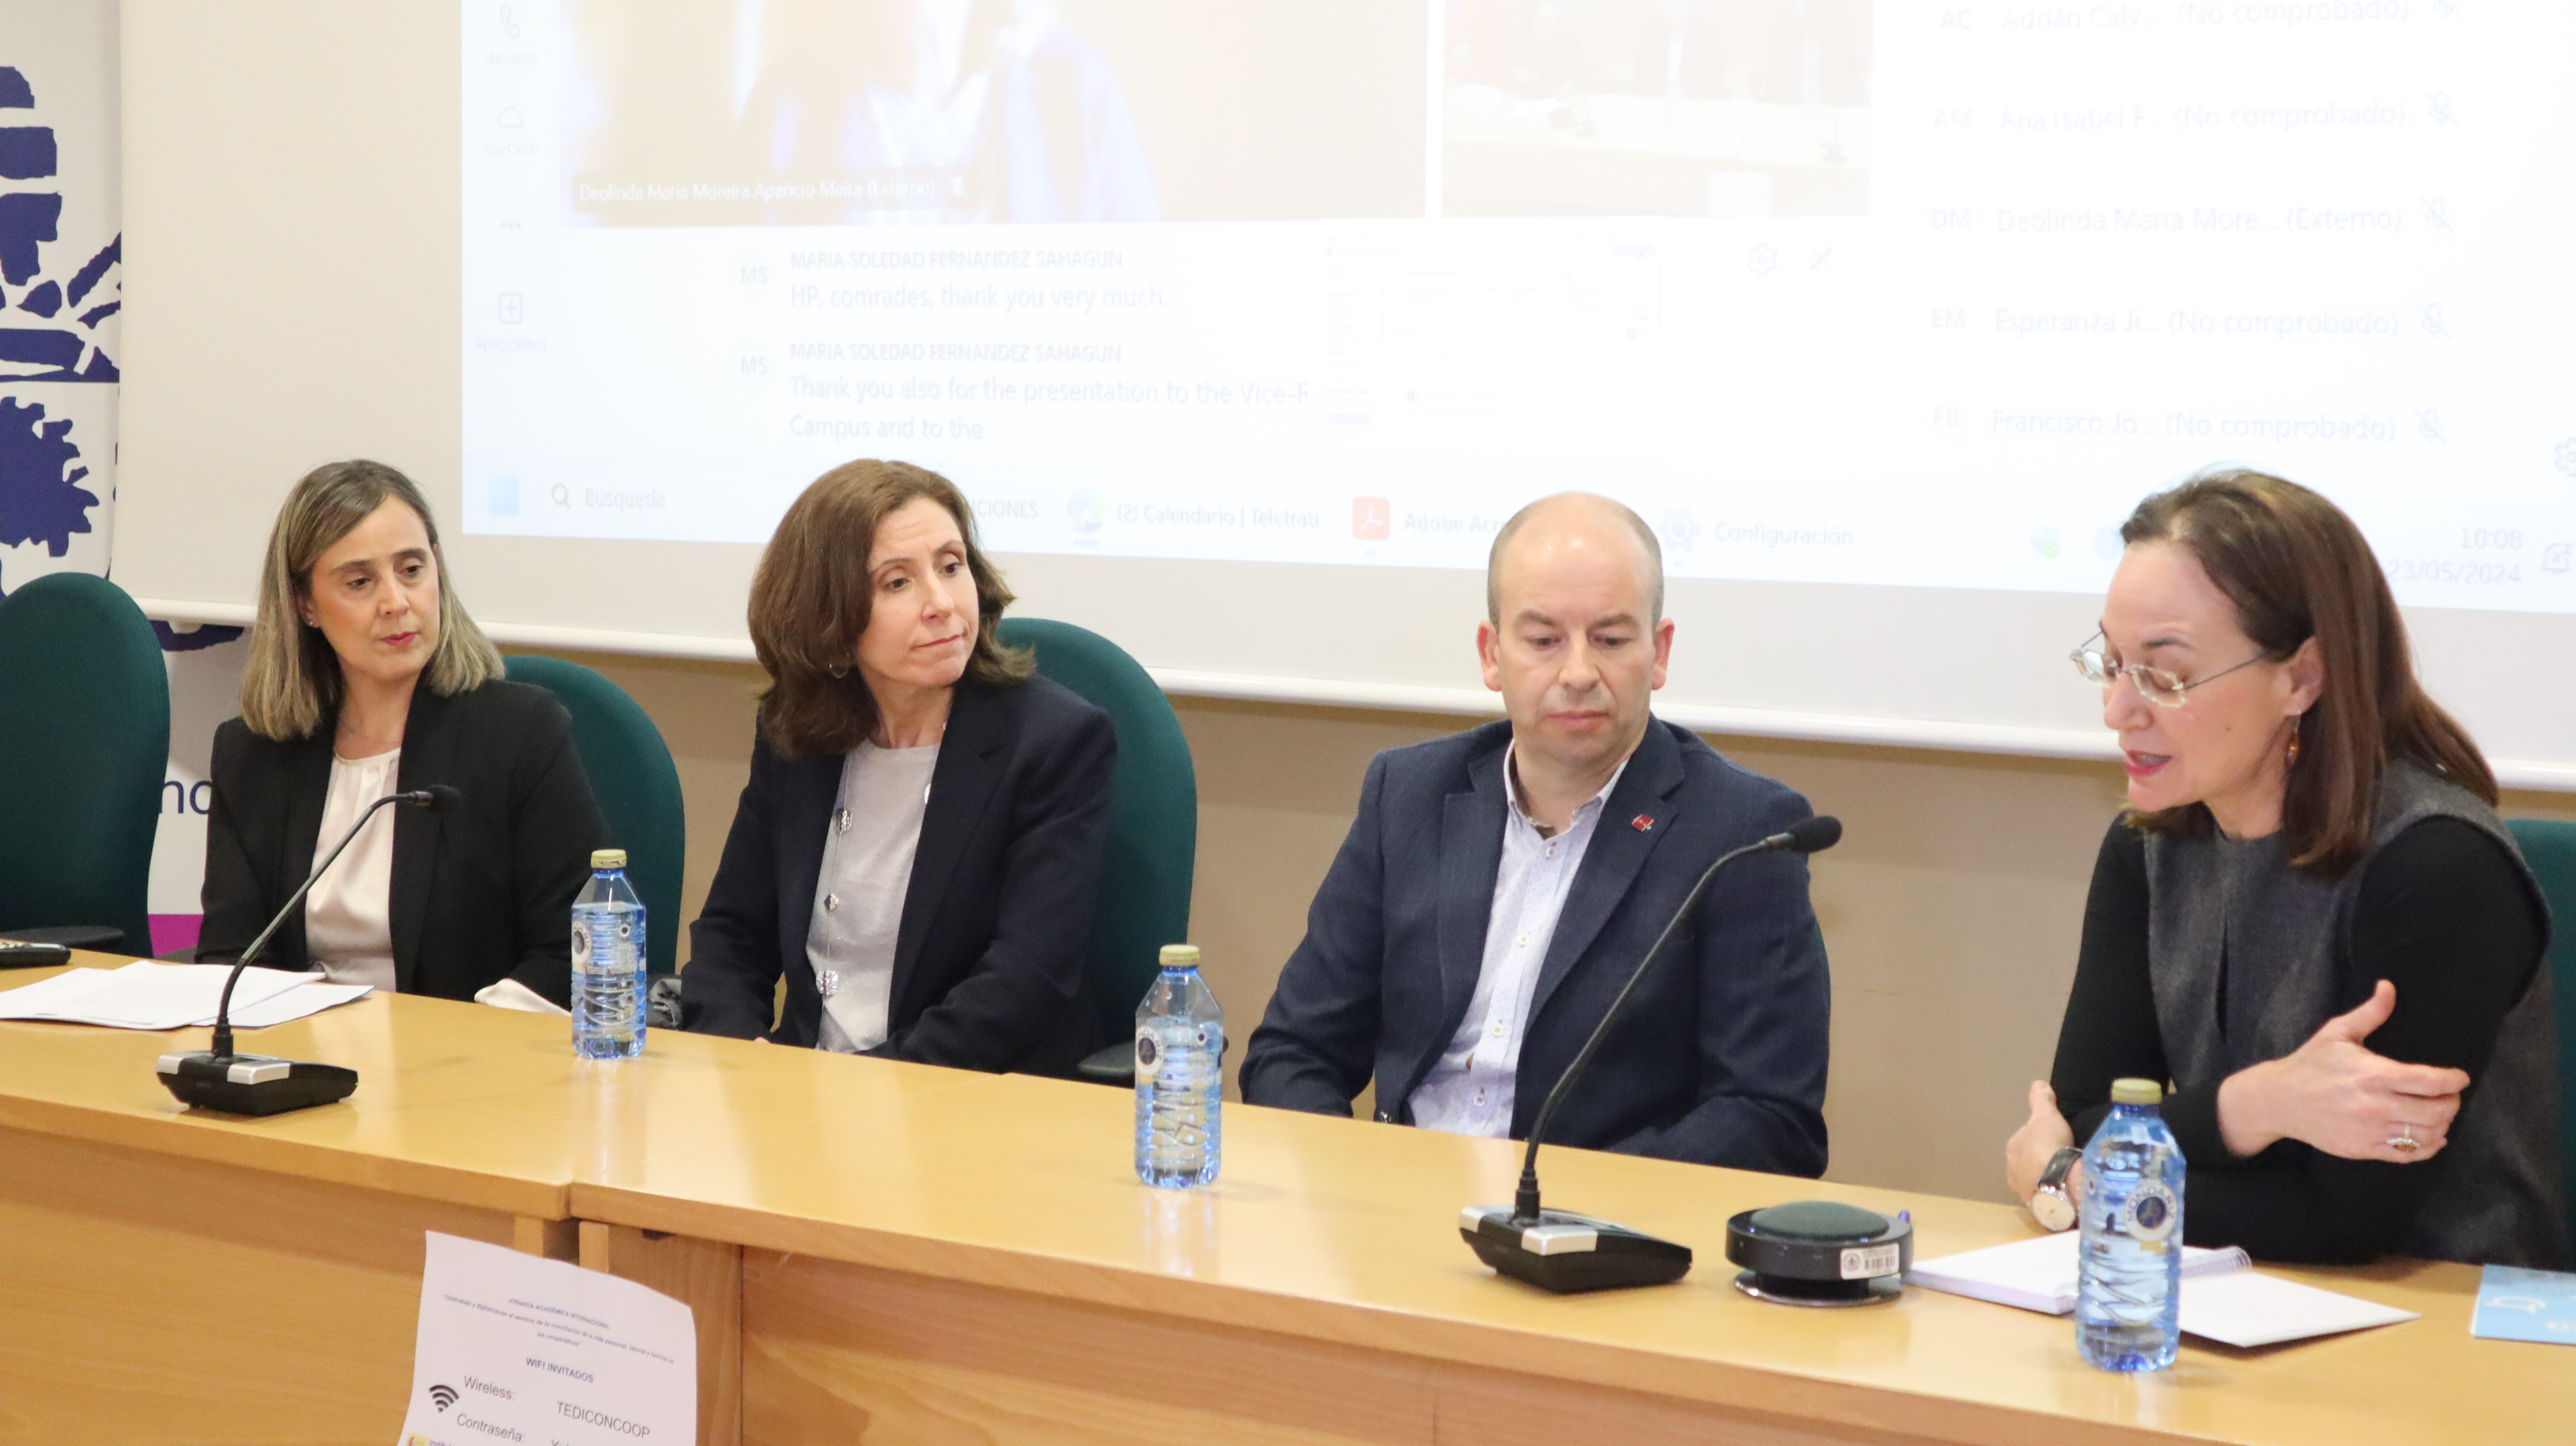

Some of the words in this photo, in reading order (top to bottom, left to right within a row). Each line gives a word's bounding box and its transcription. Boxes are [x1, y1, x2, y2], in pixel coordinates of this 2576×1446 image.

[1940, 9, 1971, 30] AC
[2178, 2, 2224, 29] (No
[2233, 0, 2409, 28] comprobado)
[1933, 109, 1972, 129] AM
[2000, 107, 2046, 131] Ana
[2054, 106, 2123, 131] Isabel
[2175, 104, 2221, 132] (No
[2229, 100, 2406, 132] comprobado)
[580, 182, 643, 202] Deolinda
[647, 183, 688, 201] Maria
[693, 182, 750, 200] Moreira
[754, 181, 815, 202] Aparicio
[820, 180, 862, 197] Meira
[867, 179, 935, 199] (Externo)
[1931, 207, 1971, 229] DM
[1998, 207, 2105, 232] Deolinda
[2114, 206, 2183, 231] Maria
[2287, 206, 2403, 233] (Externo)
[790, 252, 844, 268] MARIA
[850, 251, 925, 268] SOLEDAD
[930, 250, 1030, 268] FERNANDEZ
[1036, 250, 1123, 268] SAHAGUN
[741, 266, 768, 284] MS
[791, 284, 824, 309] HP,
[830, 283, 933, 308] comrades,
[941, 283, 998, 307] thank
[1005, 288, 1044, 314] you
[1051, 288, 1096, 314] very
[1103, 283, 1169, 307] much.
[1931, 308, 1967, 328] EM
[1996, 308, 2115, 338] Esperanza
[2169, 309, 2215, 337] (No
[2224, 310, 2399, 340] comprobado)
[741, 356, 767, 375] MS
[790, 343, 844, 360] MARIA
[849, 343, 925, 361] SOLEDAD
[930, 344, 1030, 363] FERNANDEZ
[1035, 345, 1122, 363] SAHAGUN
[790, 375, 851, 399] Thank
[857, 381, 893, 405] you
[900, 375, 941, 400] also
[948, 375, 978, 400] for
[984, 377, 1017, 401] the
[1024, 380, 1159, 407] presentation
[1167, 381, 1189, 403] to
[1195, 380, 1232, 404] the
[789, 413, 871, 443] Campus
[877, 416, 915, 439] and
[921, 417, 943, 439] to
[949, 416, 984, 440] the
[1993, 409, 2104, 434] Francisco
[2166, 412, 2213, 437] (No
[2221, 413, 2396, 443] comprobado)
[585, 486, 666, 513] Búsqueda
[1142, 504, 1235, 526] Calendario
[1250, 506, 1319, 529] Teletrab
[1403, 512, 1464, 533] Adobe
[1713, 520, 1855, 548] Configuración
[2127, 1186, 2175, 1222] MONDARIZ
[508, 1298, 534, 1309] JORNADA
[535, 1304, 569, 1317] ACADÉMICA
[570, 1313, 610, 1330] INTERNACIONAL
[514, 1315, 535, 1324] servicio
[594, 1335, 604, 1343] vida
[526, 1357, 546, 1370] WIFI
[547, 1362, 594, 1384] INVITADOS
[464, 1375, 515, 1401] Wireless:
[456, 1413, 526, 1443] Contraseña:
[557, 1401, 650, 1439] TEDICONCOOP
